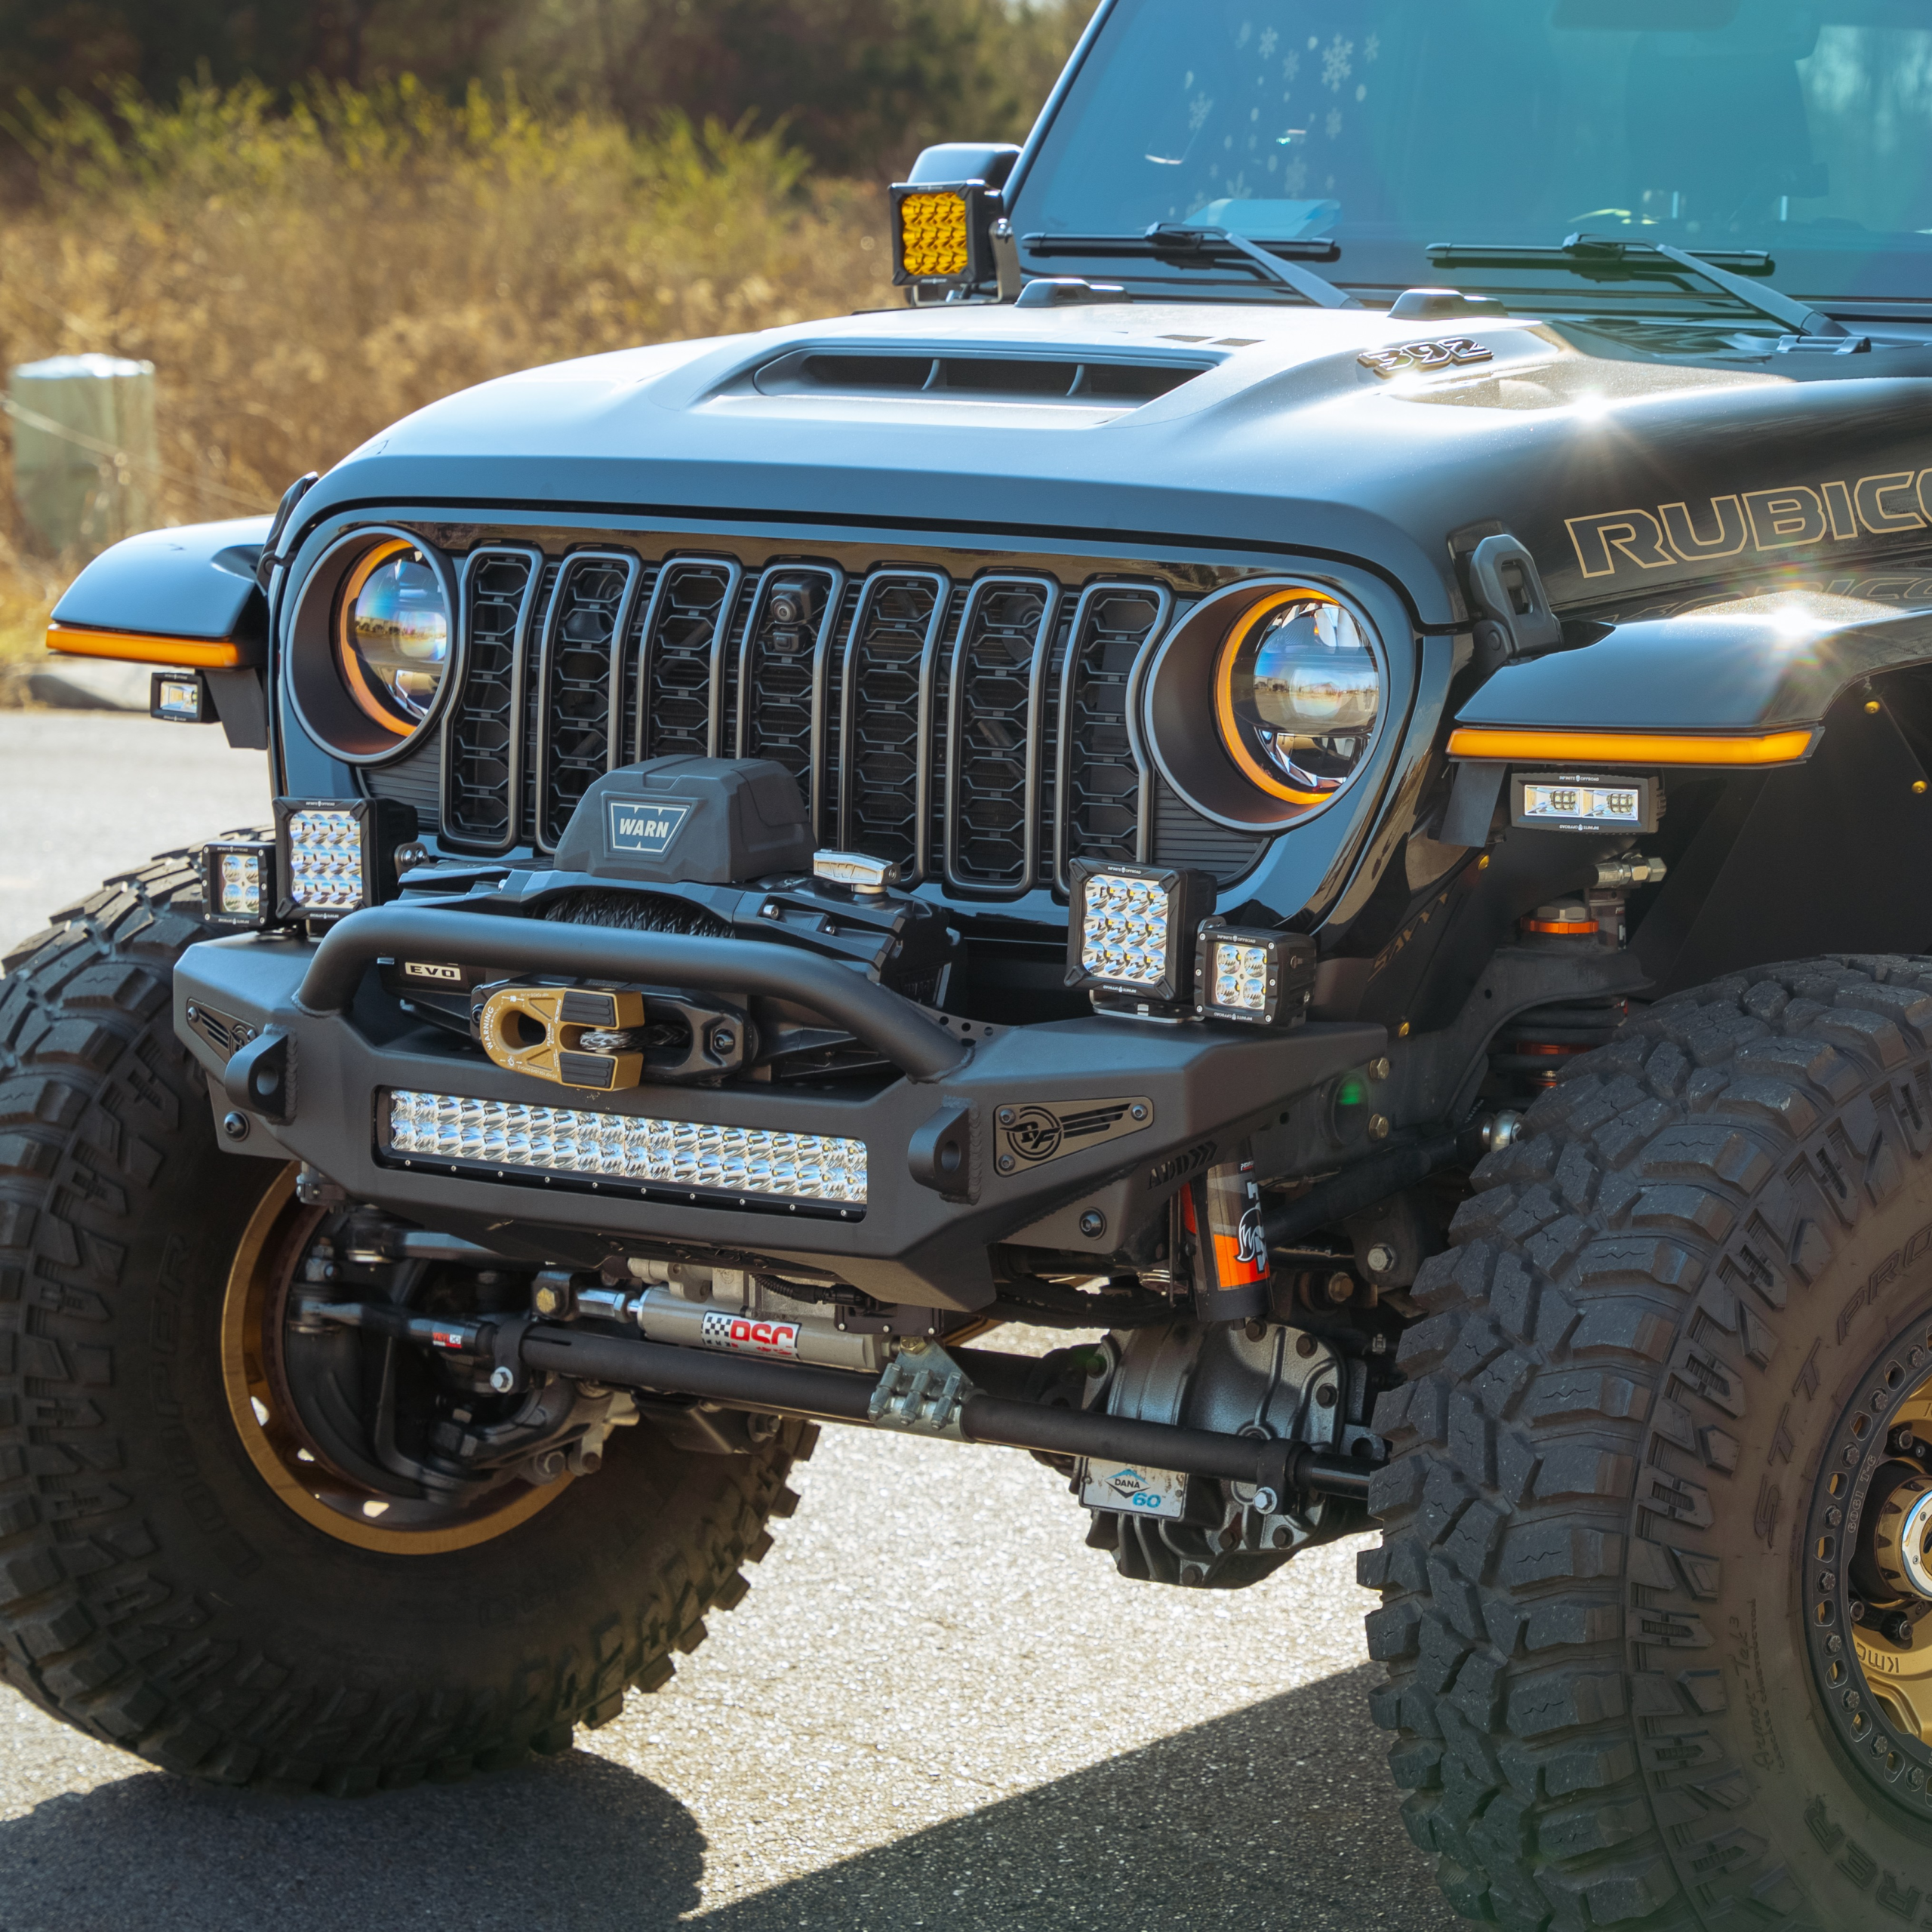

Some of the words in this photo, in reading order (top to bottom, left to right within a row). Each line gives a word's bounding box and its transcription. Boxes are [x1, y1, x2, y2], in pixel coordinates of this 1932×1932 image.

[1357, 337, 1494, 380] 392
[1564, 468, 1932, 579] RUBIC
[620, 818, 669, 838] WARN
[410, 965, 455, 977] EVO
[483, 1006, 494, 1051] WARNING
[1115, 1479, 1140, 1489] DANA
[1133, 1492, 1161, 1508] 60
